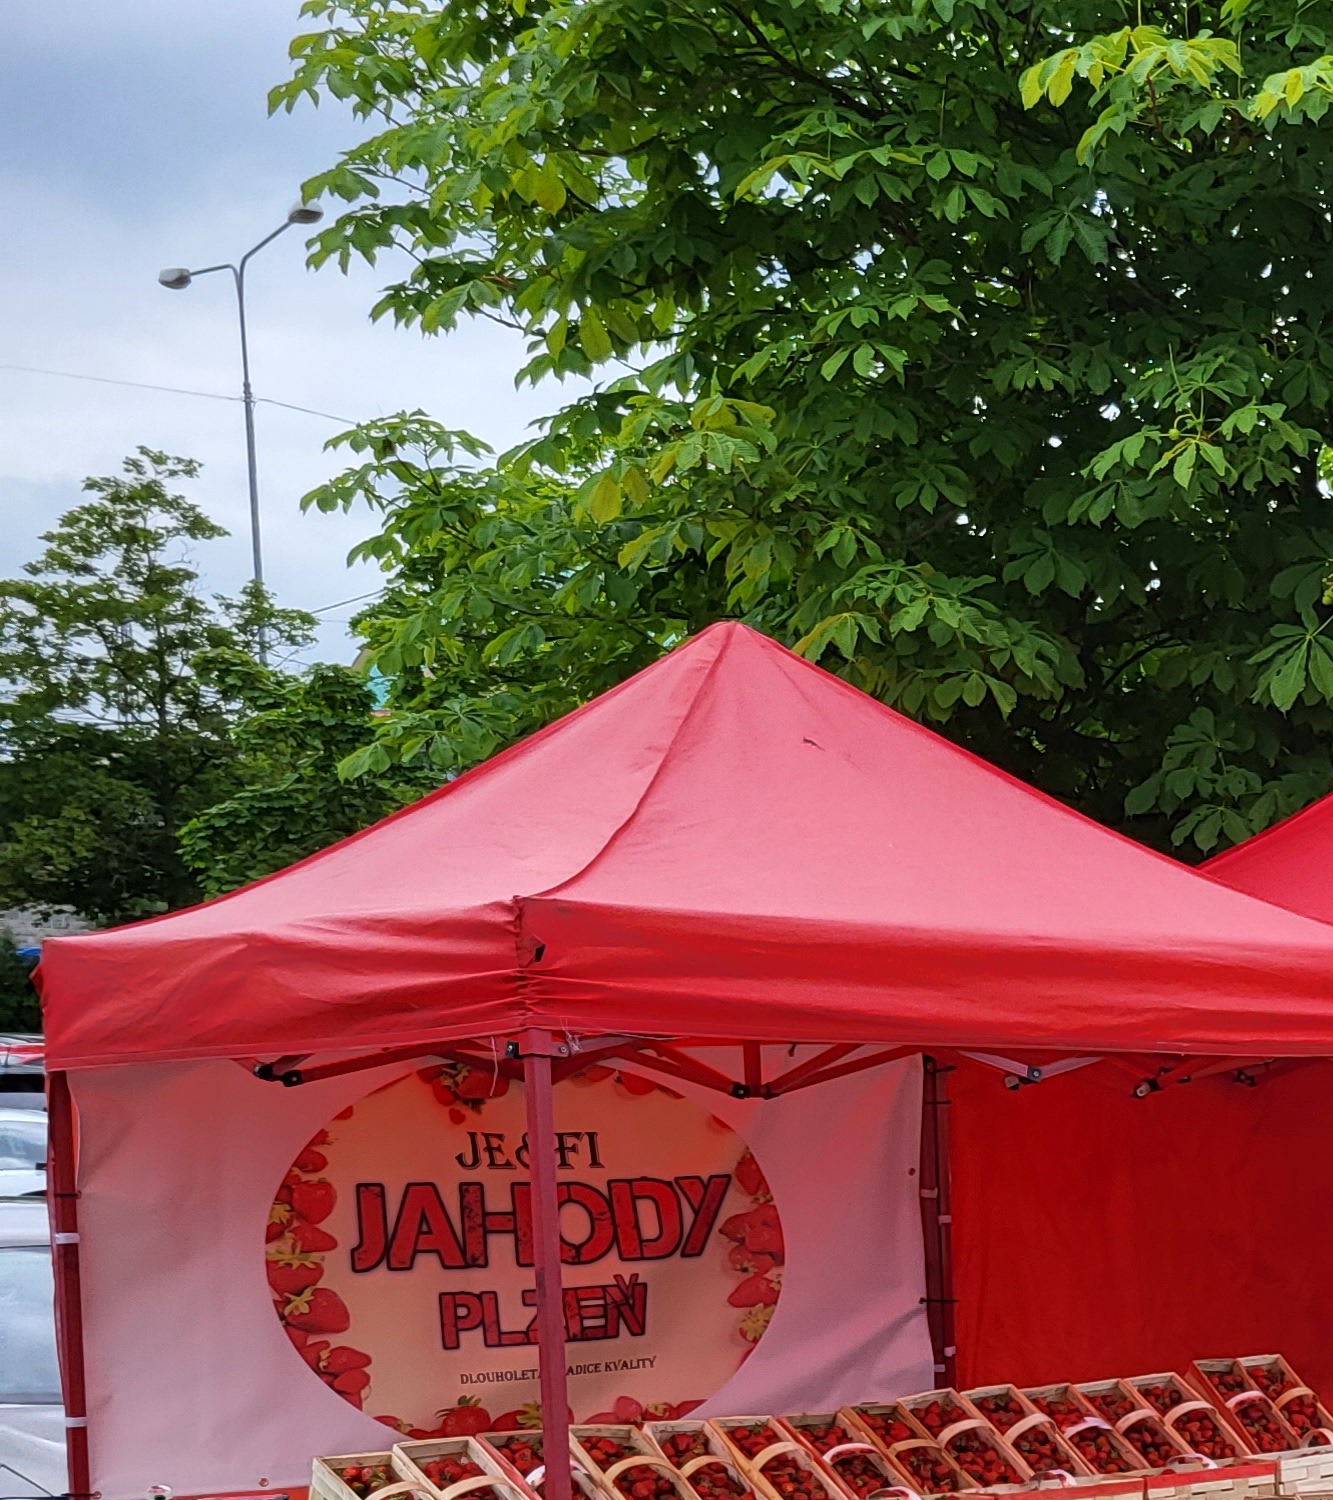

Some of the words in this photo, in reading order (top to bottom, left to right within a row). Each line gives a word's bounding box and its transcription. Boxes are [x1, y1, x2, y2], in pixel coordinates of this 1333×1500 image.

[350, 1174, 732, 1273] JAHODY
[460, 1368, 541, 1385] DLOUHOLET
[567, 1362, 602, 1376] ADICE
[604, 1356, 657, 1371] KVALITY
